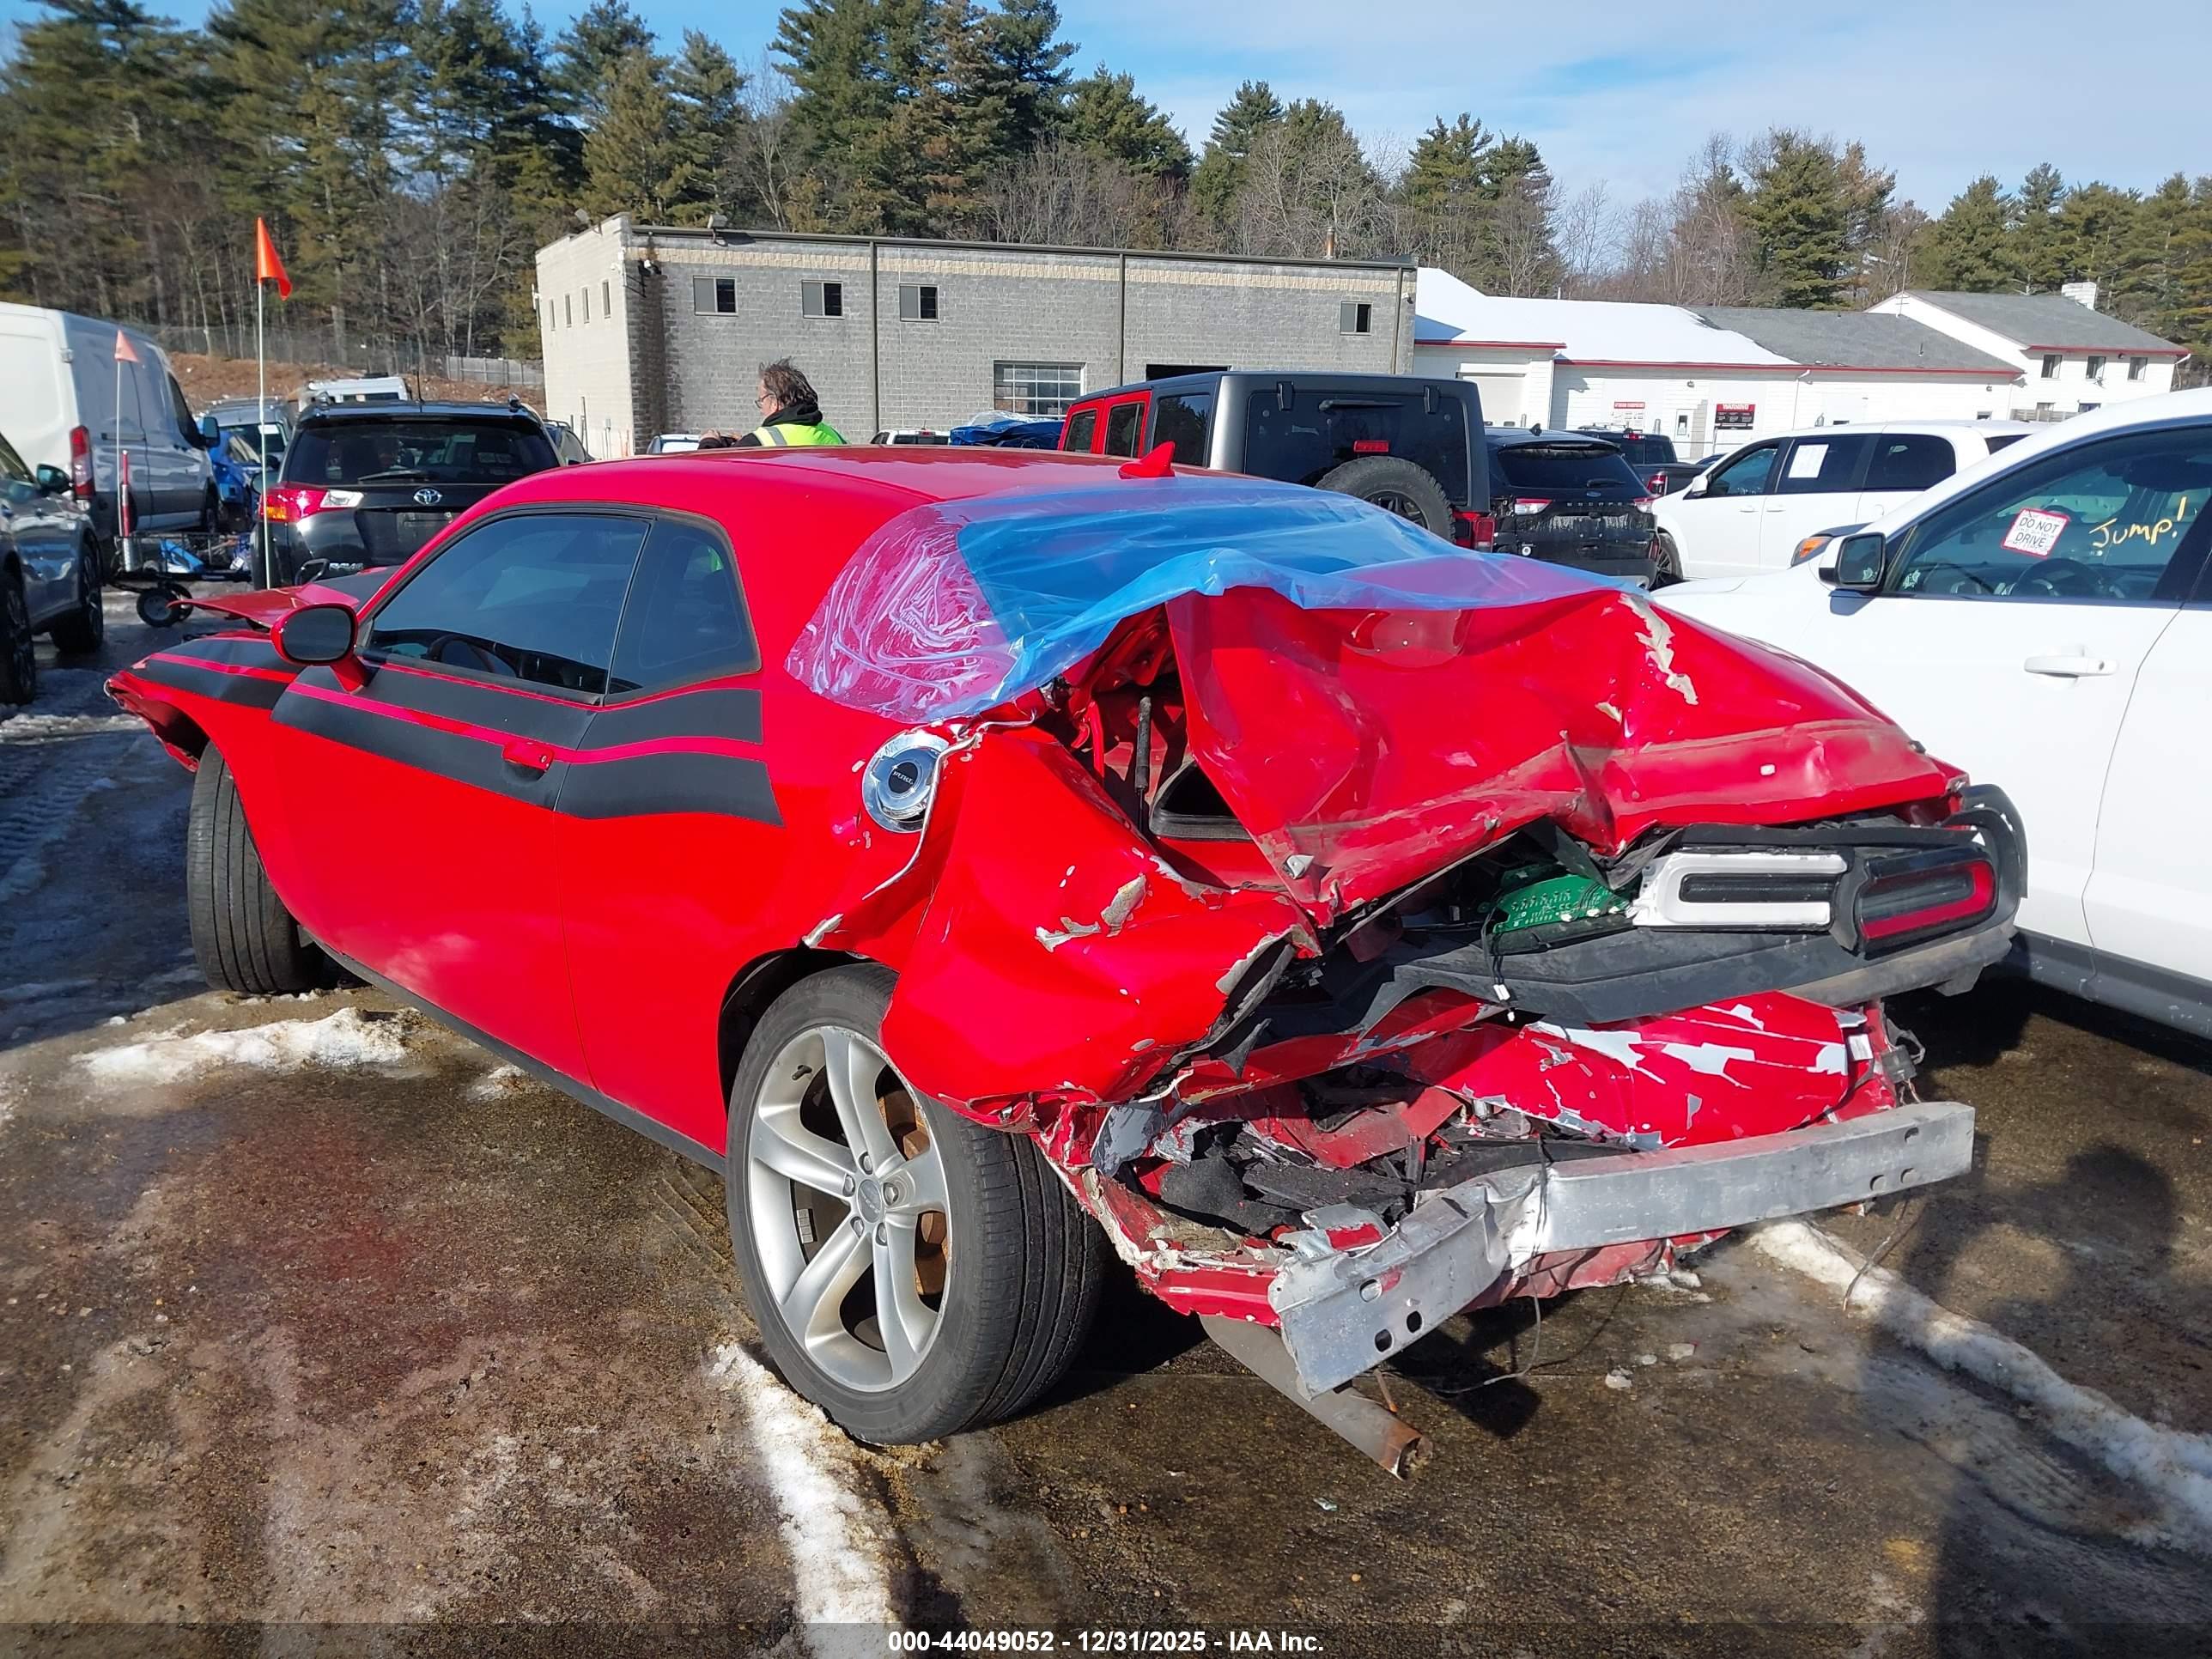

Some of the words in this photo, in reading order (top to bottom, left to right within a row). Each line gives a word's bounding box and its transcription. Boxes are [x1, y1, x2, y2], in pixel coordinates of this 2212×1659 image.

[2019, 517, 2035, 528] DO
[2035, 520, 2060, 533] NOT
[2089, 496, 2188, 547] Jump!
[2015, 532, 2046, 547] DRIVE
